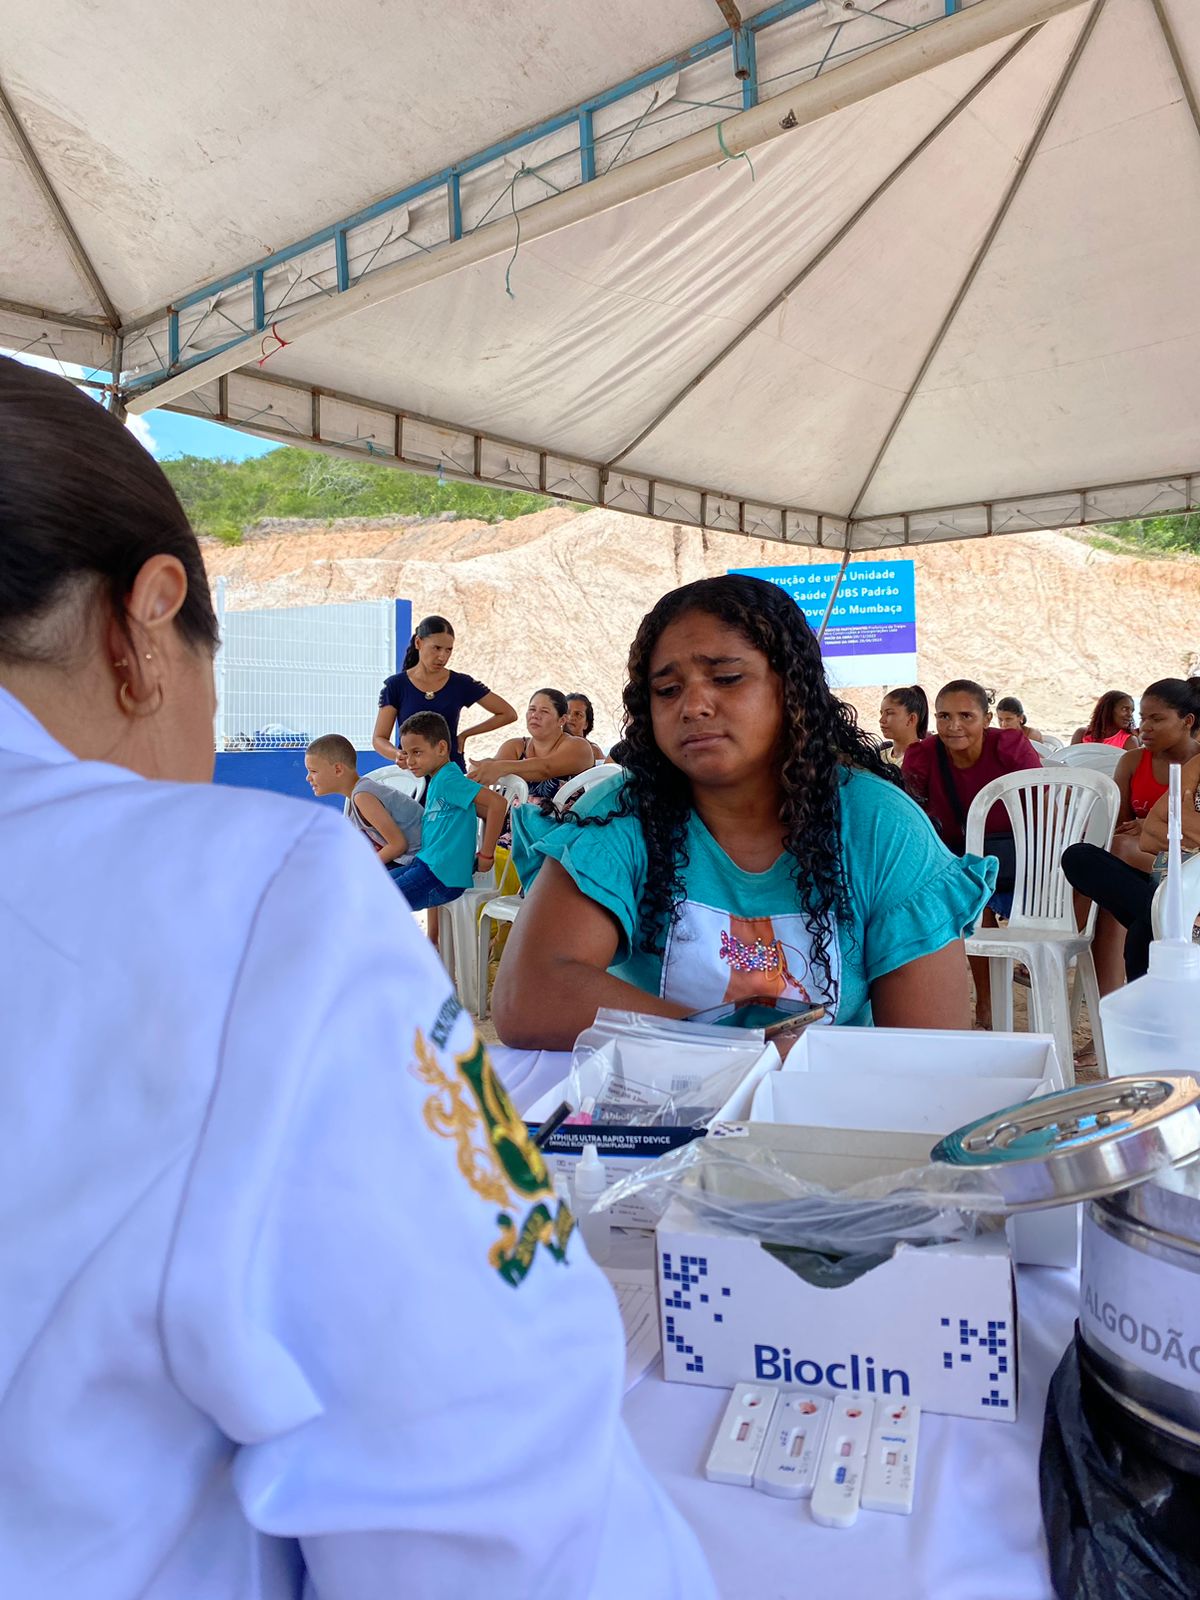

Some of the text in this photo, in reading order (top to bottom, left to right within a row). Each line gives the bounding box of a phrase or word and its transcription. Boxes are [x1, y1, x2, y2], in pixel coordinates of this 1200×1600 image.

[808, 574, 821, 584] de
[849, 570, 896, 581] Unidade
[793, 586, 900, 601] Saúde UBS Padrão
[849, 603, 903, 615] Mumbaça
[579, 1134, 600, 1142] ULTRA
[602, 1135, 623, 1143] RAPID
[643, 1136, 671, 1144] DEVICE
[754, 1344, 910, 1396] Bioclin
